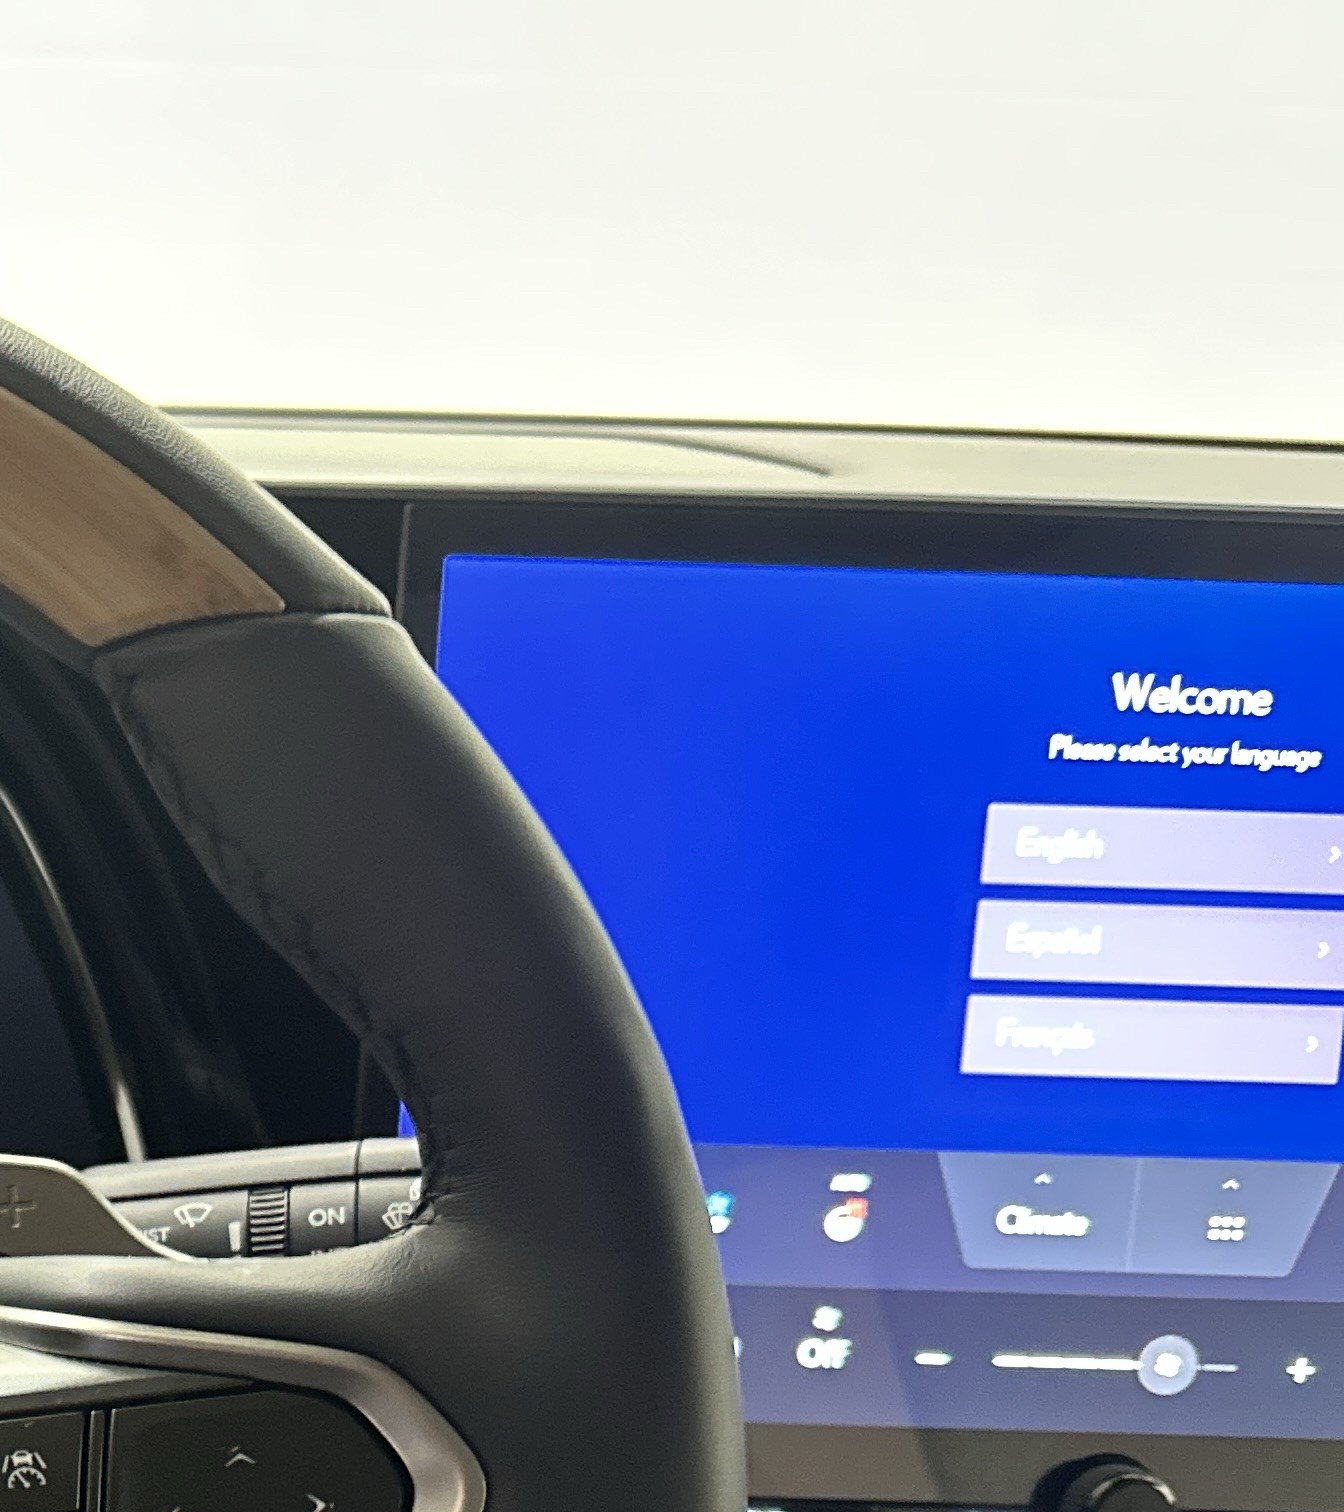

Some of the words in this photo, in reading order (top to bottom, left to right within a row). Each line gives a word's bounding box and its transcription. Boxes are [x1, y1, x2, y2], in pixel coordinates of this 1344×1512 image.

[1111, 671, 1274, 717] Welcome
[1048, 733, 1117, 761] Please
[1118, 737, 1180, 764] select
[1181, 747, 1231, 769] your
[1230, 740, 1323, 773] language
[1016, 826, 1105, 864] English
[1005, 922, 1104, 959] Español
[995, 1016, 1096, 1056] Français
[307, 1207, 346, 1227] ON
[995, 1204, 1091, 1237] Climate
